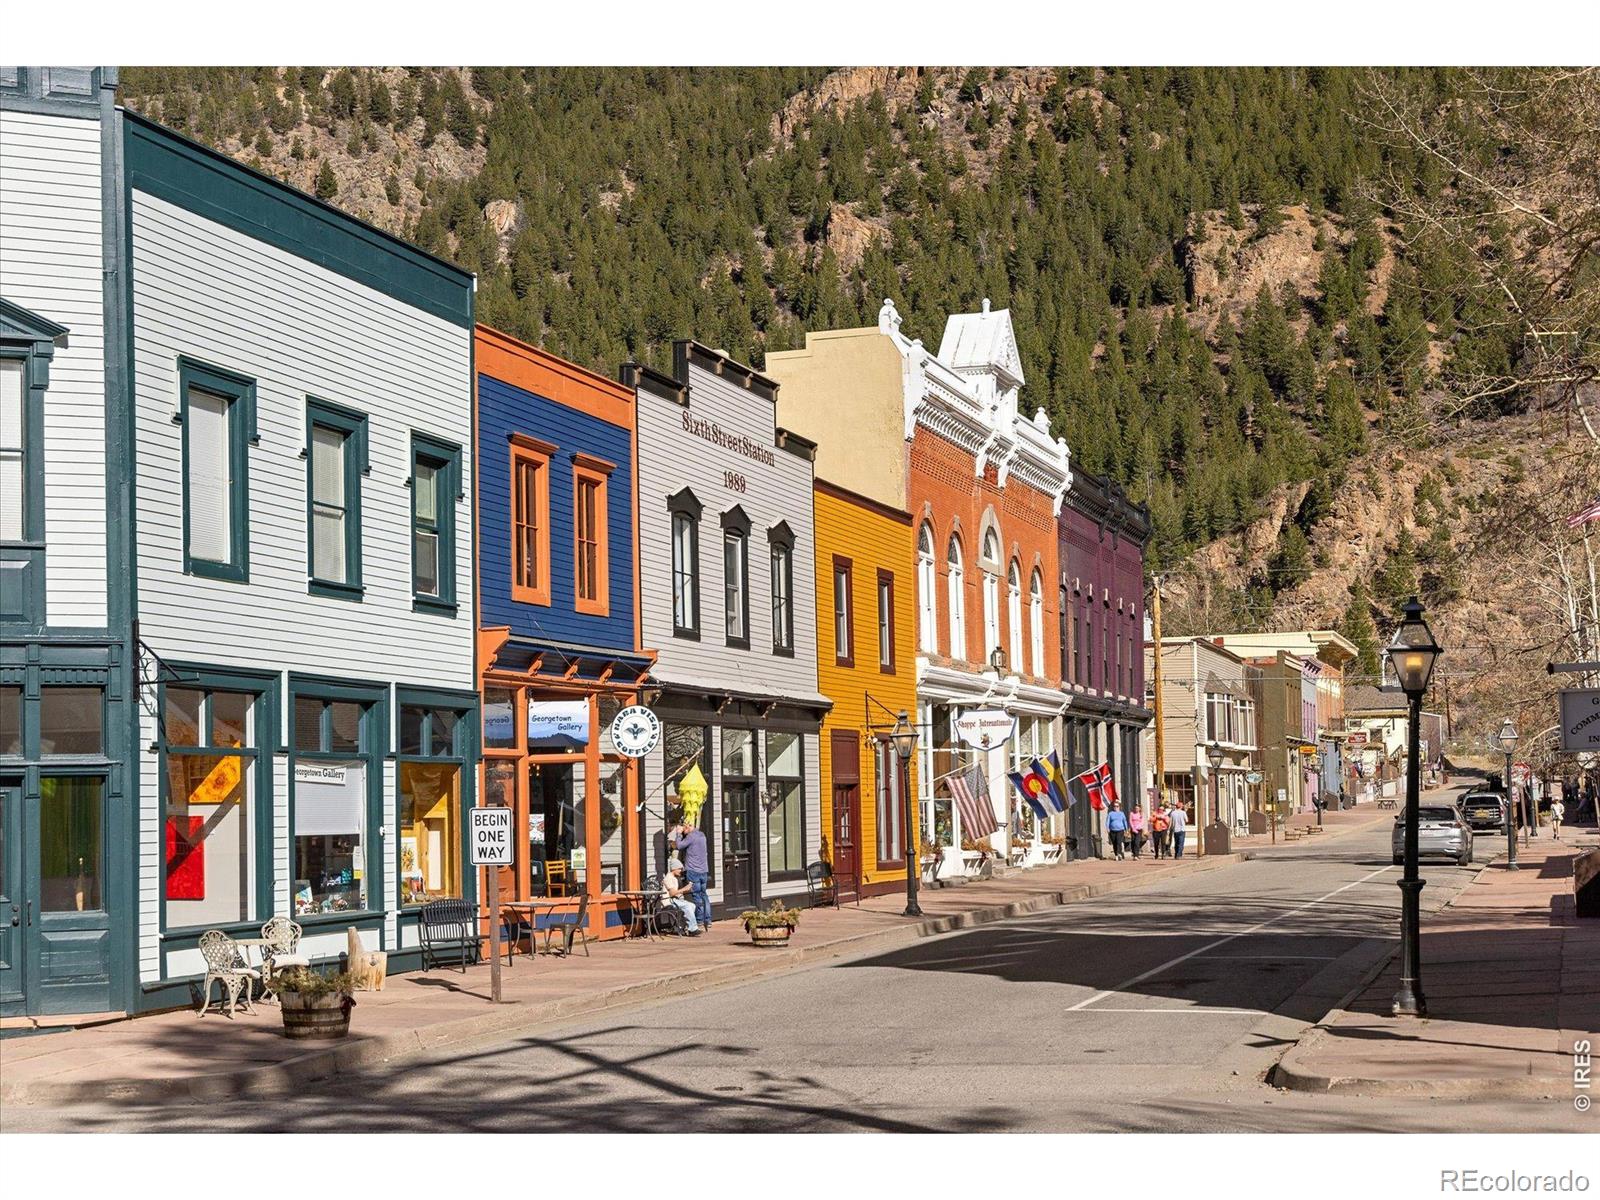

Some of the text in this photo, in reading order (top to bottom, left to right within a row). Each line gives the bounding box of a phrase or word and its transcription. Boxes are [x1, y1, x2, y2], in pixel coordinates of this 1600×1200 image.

[532, 714, 571, 724] Georgetown
[640, 708, 658, 730] VISA
[558, 723, 582, 732] Gallery
[617, 741, 654, 755] COFFEE
[296, 768, 345, 781] eorgetown Gallery
[475, 814, 507, 826] BEGIN
[478, 830, 505, 842] ONE
[478, 847, 505, 858] WAY
